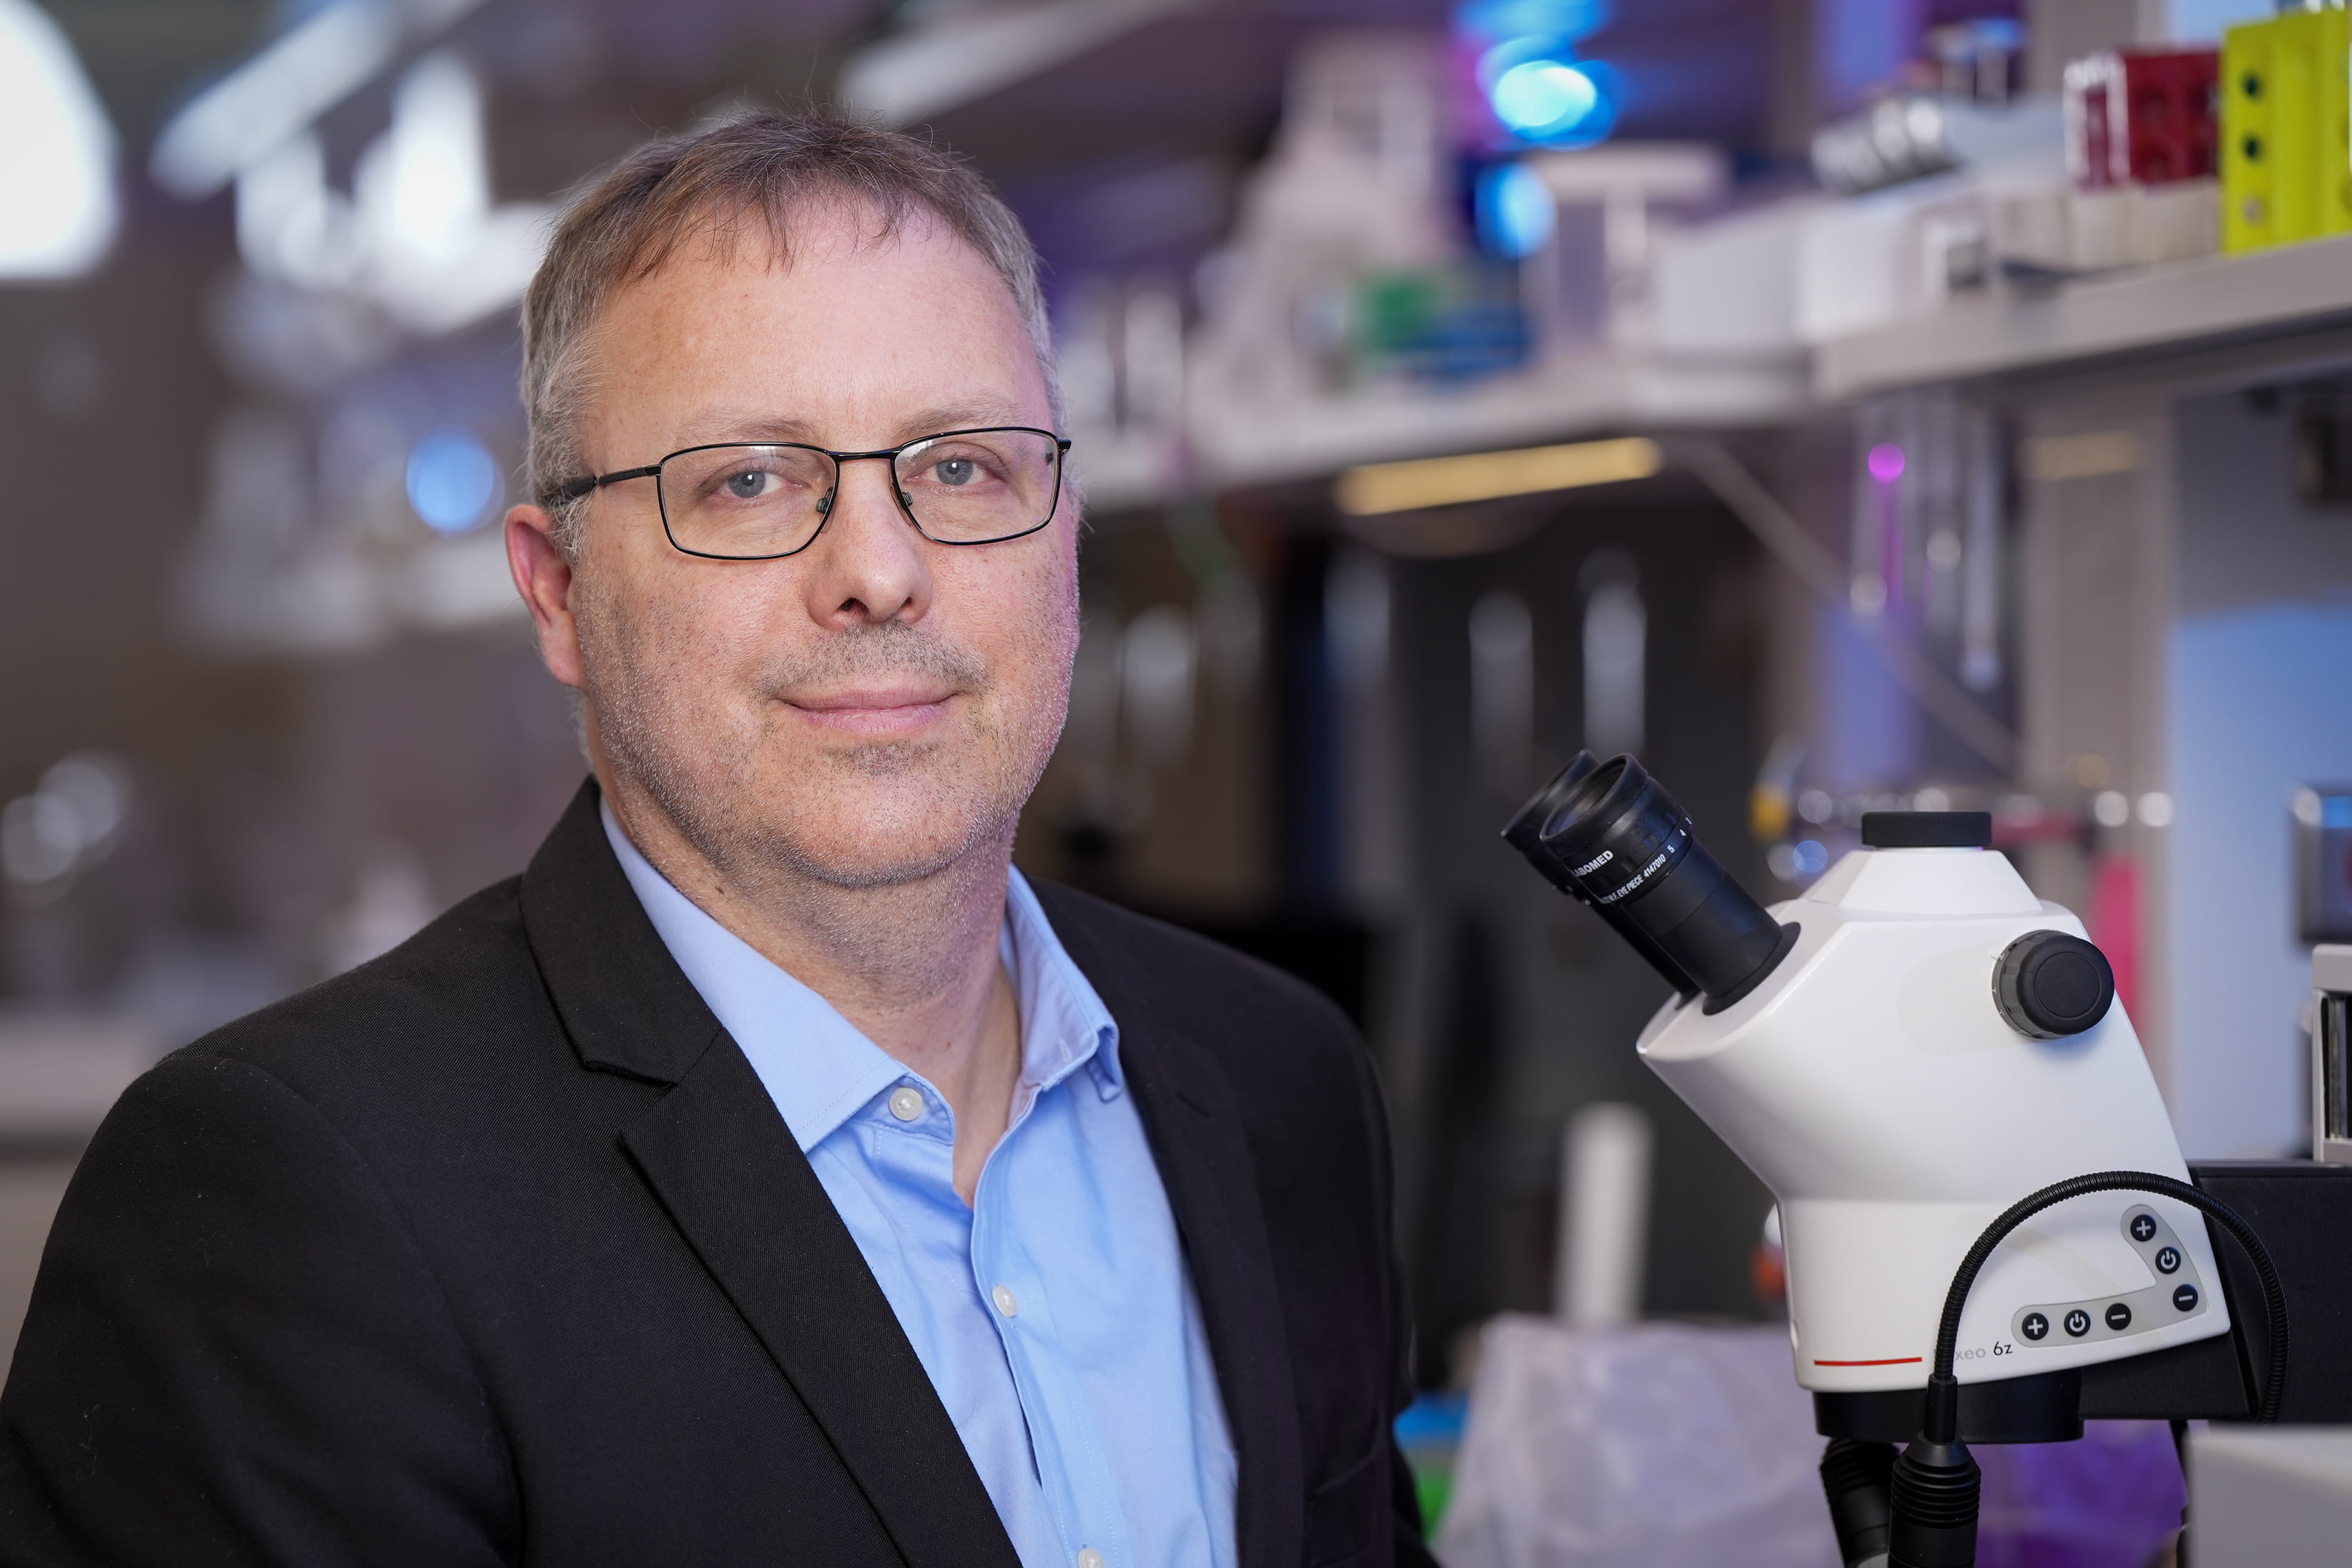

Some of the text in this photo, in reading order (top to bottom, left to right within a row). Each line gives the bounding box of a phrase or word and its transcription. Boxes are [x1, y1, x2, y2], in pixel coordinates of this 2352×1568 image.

[1667, 844, 1675, 853] 5
[1573, 850, 1614, 877] ABOMED
[1644, 853, 1666, 877] 4147010
[1954, 1341, 2013, 1361] xeo 6z
